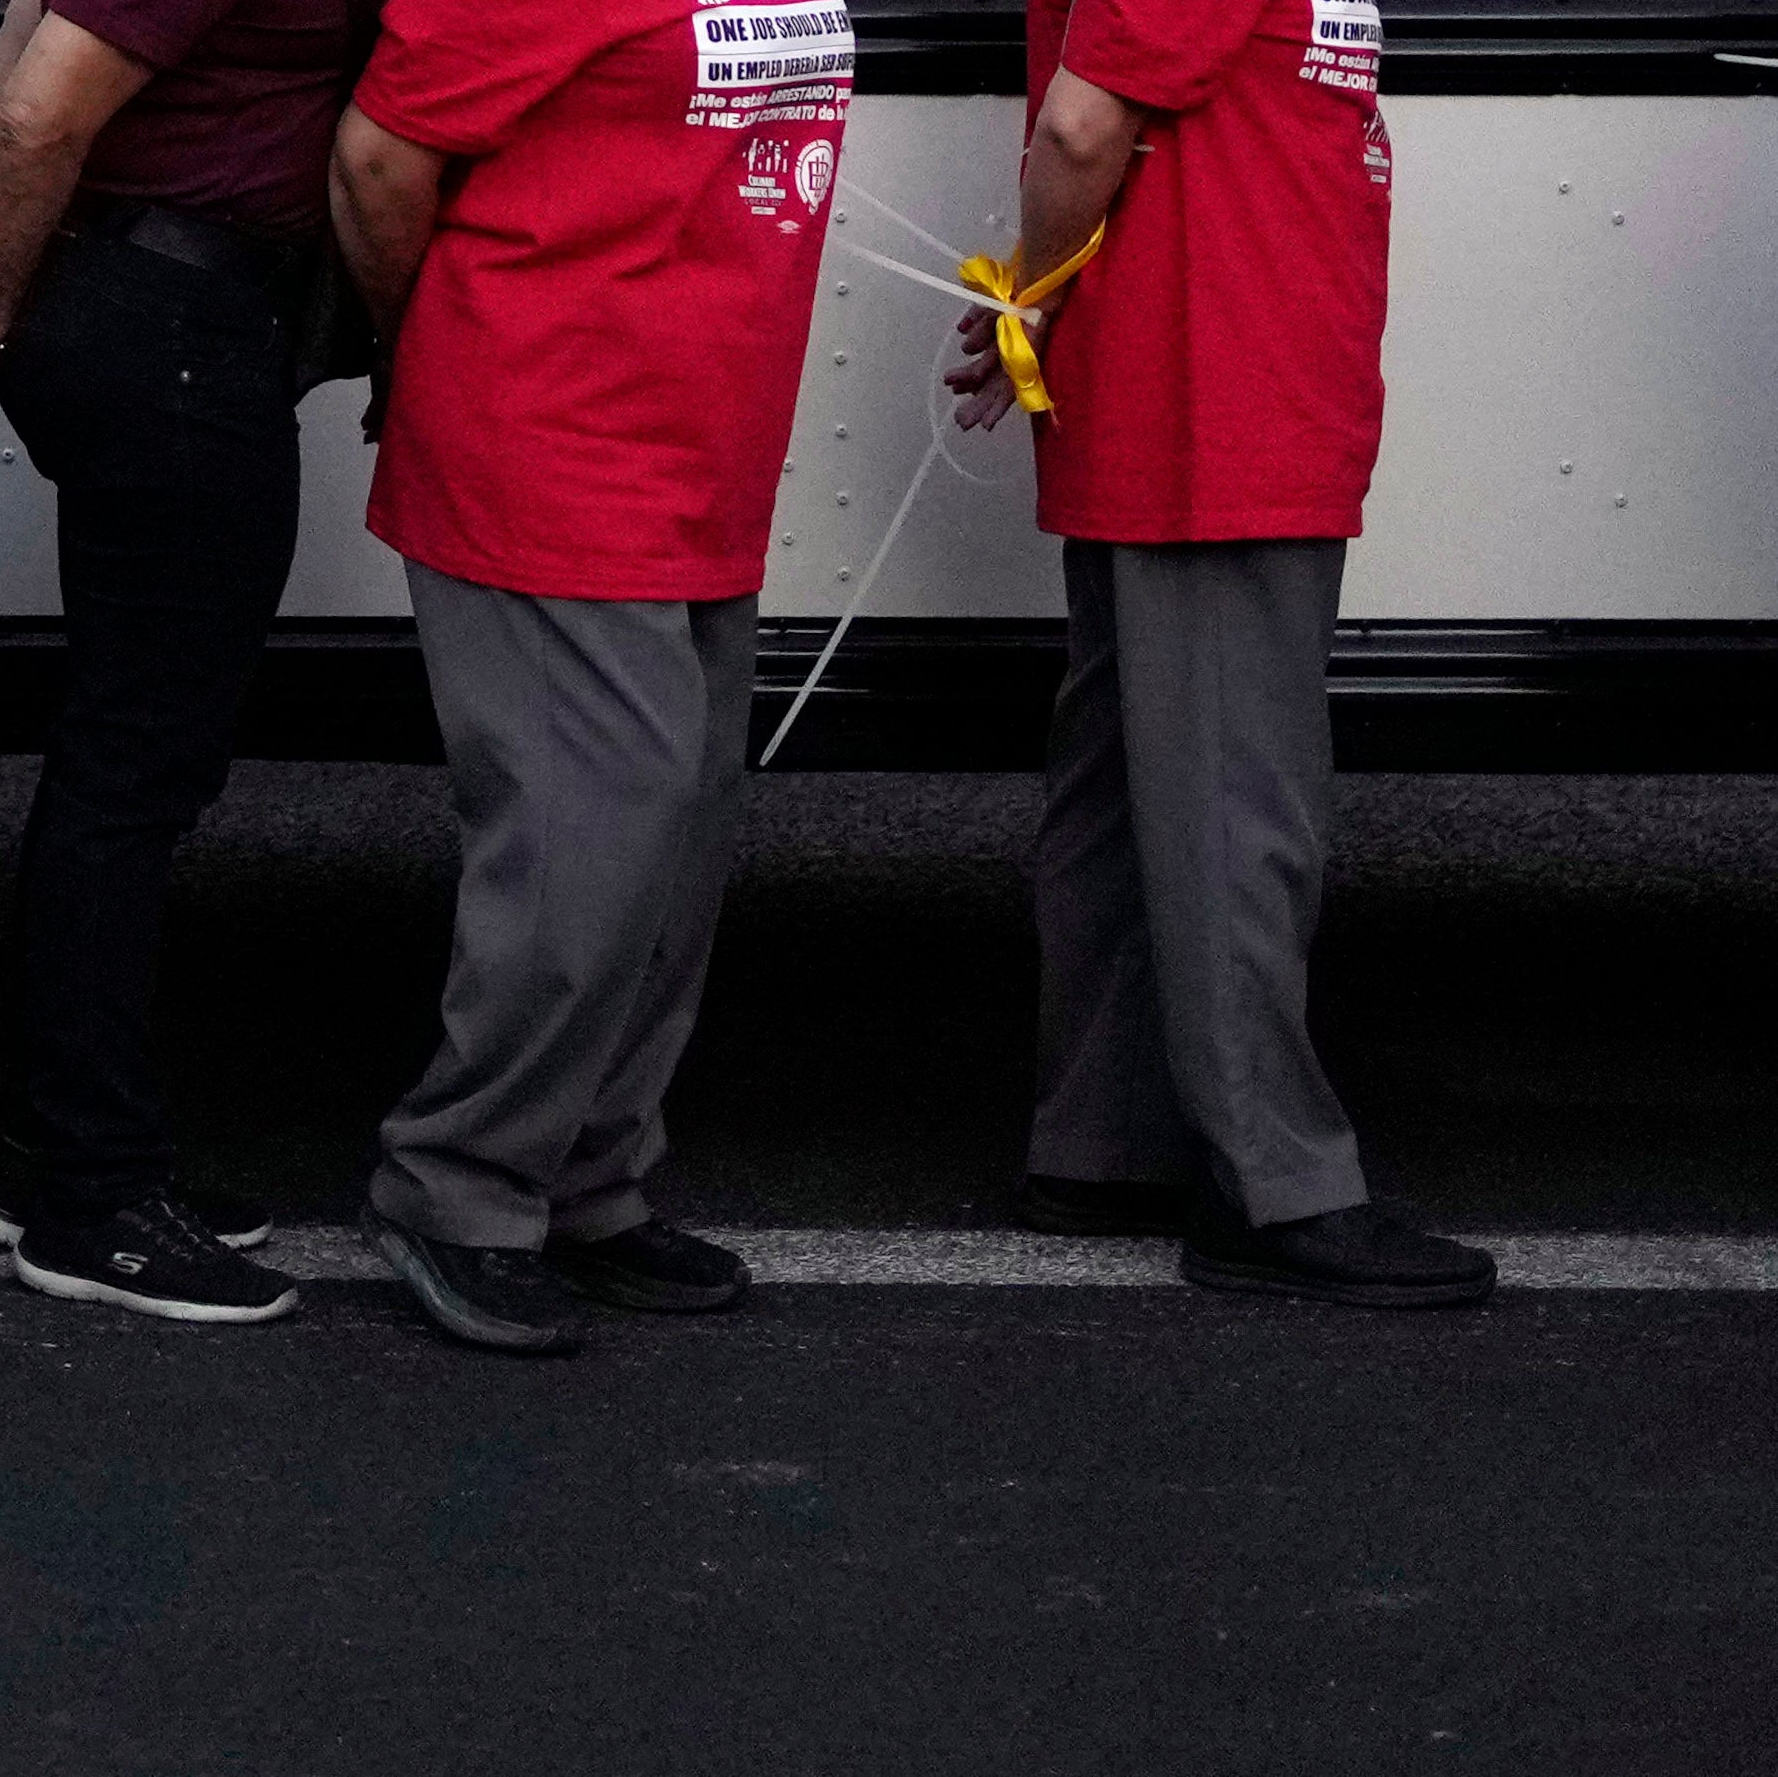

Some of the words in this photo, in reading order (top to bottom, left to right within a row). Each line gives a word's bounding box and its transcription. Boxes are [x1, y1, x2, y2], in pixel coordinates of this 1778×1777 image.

[706, 17, 748, 42] ONE
[749, 17, 777, 40] JOB
[775, 13, 822, 38] SHOULD
[820, 10, 837, 34] BE
[1320, 21, 1340, 39] UN
[708, 62, 732, 81] UN
[737, 59, 782, 80] EMPLEO
[1298, 66, 1315, 81] el
[1318, 69, 1369, 91] MEJOR
[766, 85, 834, 104] ARRESTANDO
[685, 111, 704, 126] el
[818, 104, 835, 121] de
